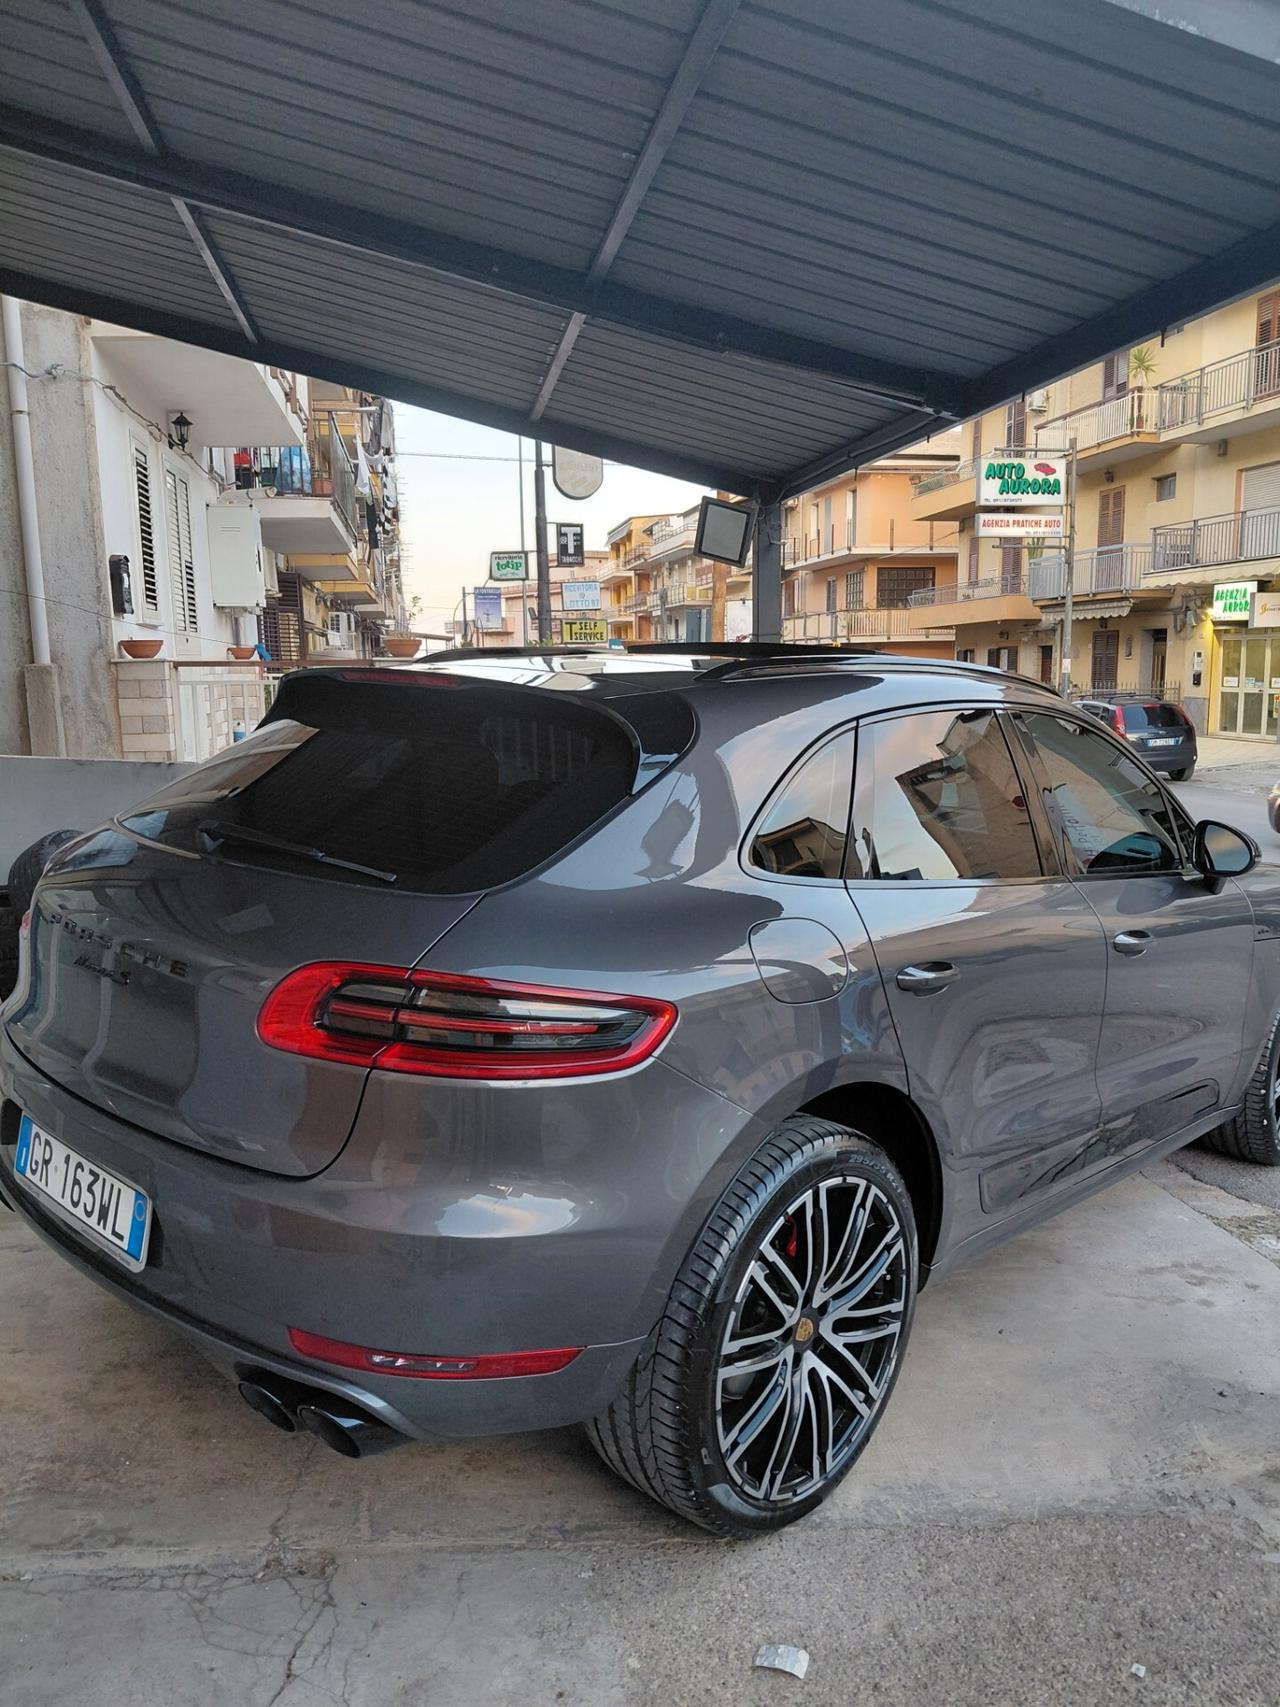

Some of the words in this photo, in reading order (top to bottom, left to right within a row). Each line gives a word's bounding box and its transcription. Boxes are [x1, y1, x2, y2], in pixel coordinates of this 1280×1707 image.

[985, 462, 1025, 480] AUTO
[999, 478, 1061, 496] AURORA
[982, 519, 1010, 528] AGENZIA
[1012, 519, 1042, 528] PRATICHE
[1044, 519, 1061, 528] AUTO
[561, 526, 581, 554] T
[496, 560, 522, 571] totip
[564, 584, 598, 592] RICEVITORIA
[1215, 587, 1248, 602] AGENZIA
[565, 600, 590, 608] LOTTO
[1223, 600, 1249, 613] AUROR
[579, 621, 598, 631] SELF
[574, 631, 605, 641] SERVICE
[29, 1131, 53, 1188] GR
[61, 1153, 125, 1243] 163WL
